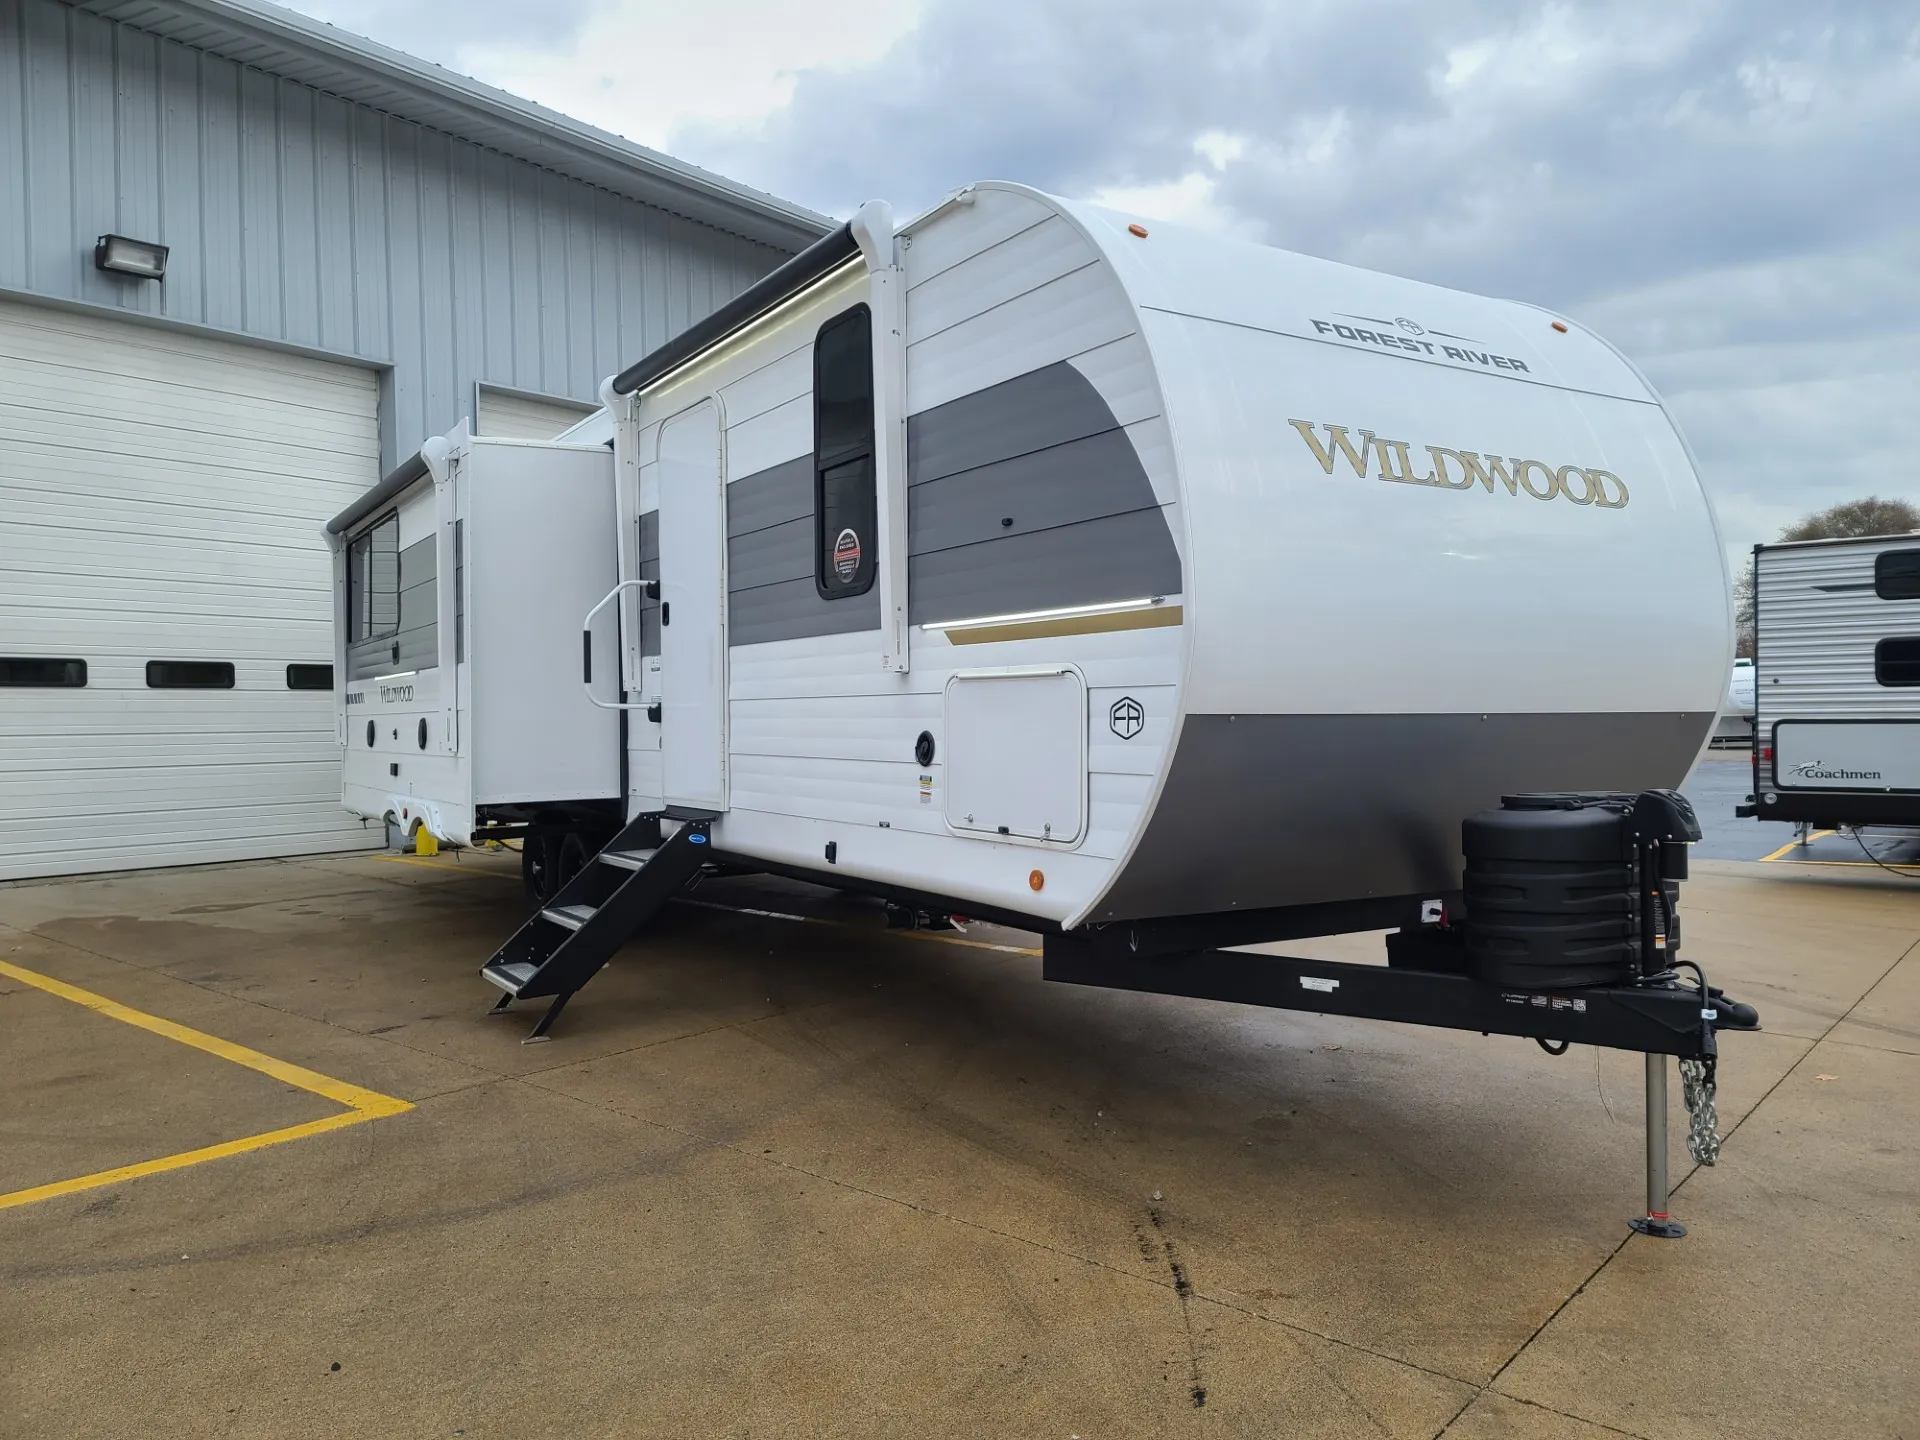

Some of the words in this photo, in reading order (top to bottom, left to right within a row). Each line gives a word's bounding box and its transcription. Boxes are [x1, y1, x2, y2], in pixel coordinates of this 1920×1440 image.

[1309, 318, 1435, 355] FOREST
[1440, 344, 1532, 374] RIVER
[1288, 418, 1630, 509] WILDWOOD
[1804, 768, 1882, 780] Coachmen
